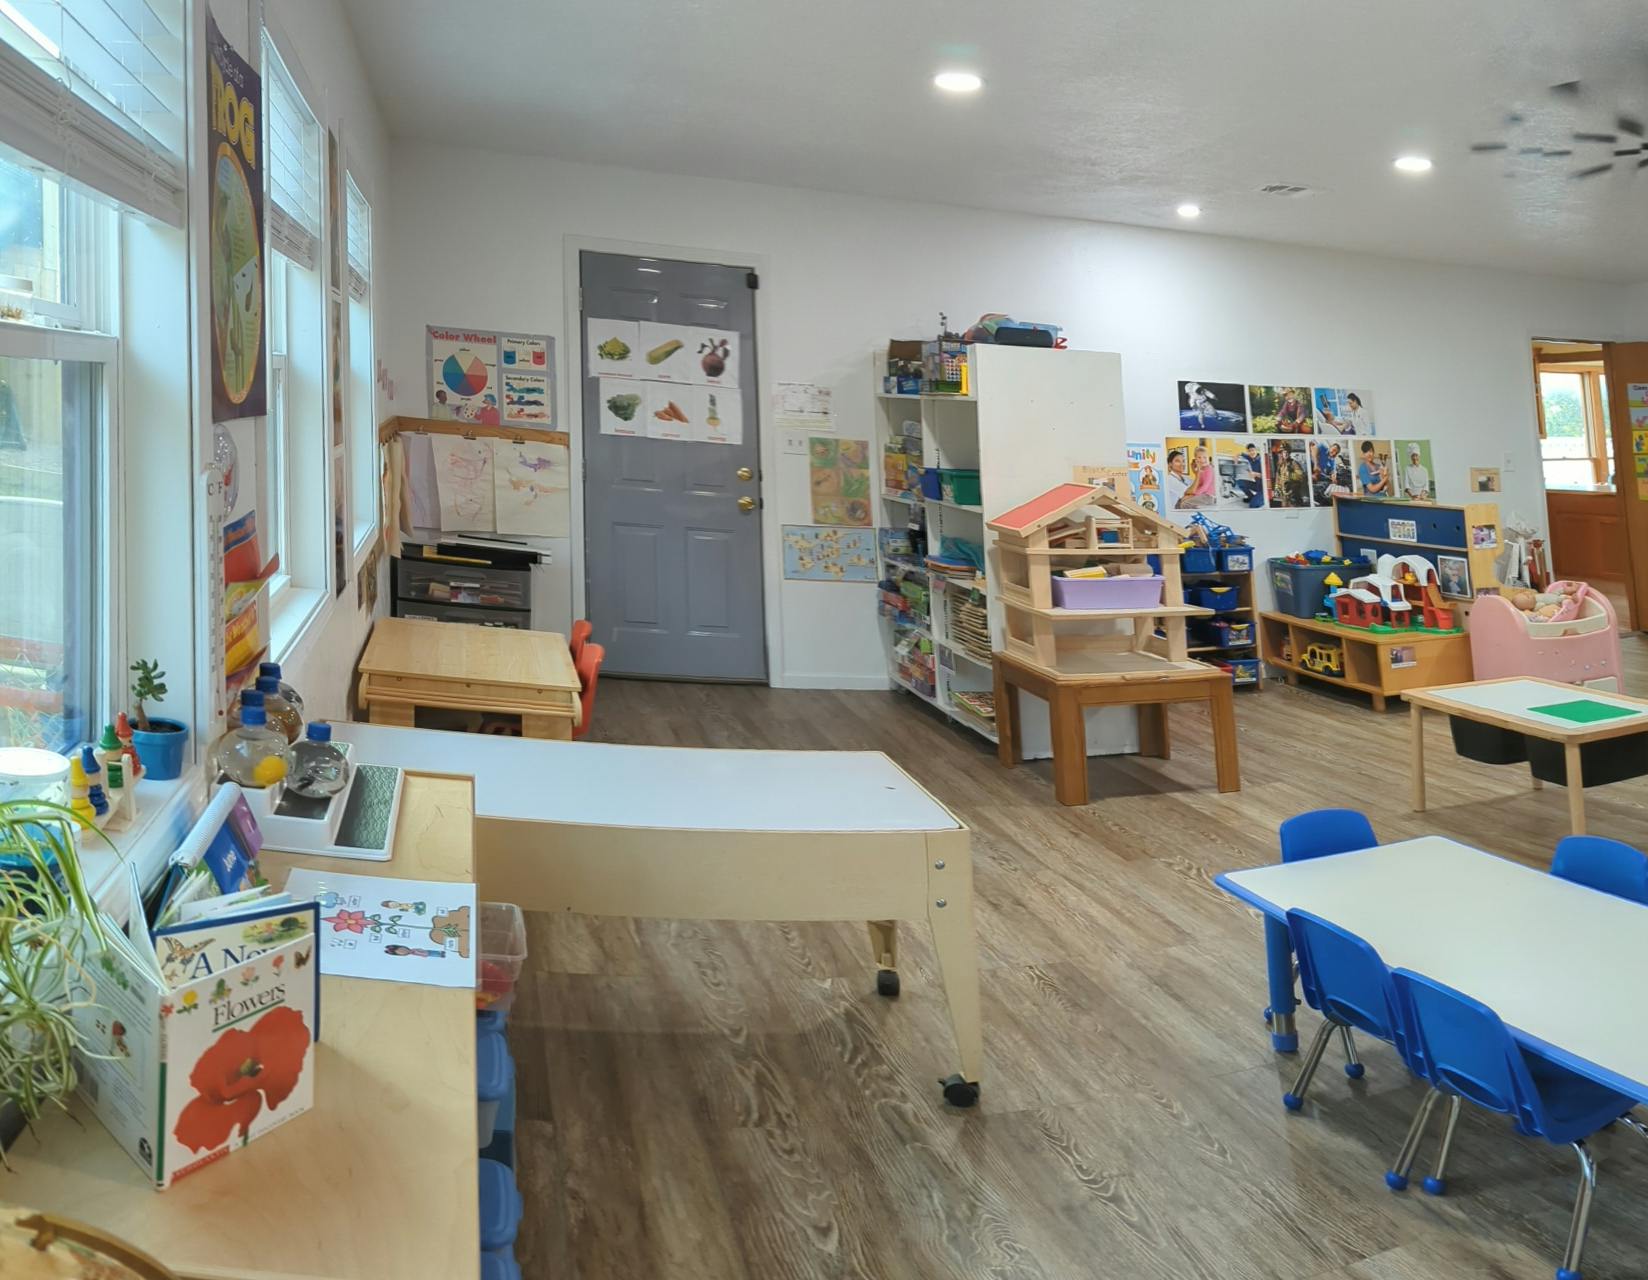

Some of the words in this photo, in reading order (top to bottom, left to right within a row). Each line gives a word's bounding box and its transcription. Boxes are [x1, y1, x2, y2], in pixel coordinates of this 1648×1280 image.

[432, 330, 460, 341] Color
[463, 333, 497, 344] Wheel
[208, 482, 214, 497] C
[217, 481, 223, 495] F
[212, 983, 287, 1027] Flowers
